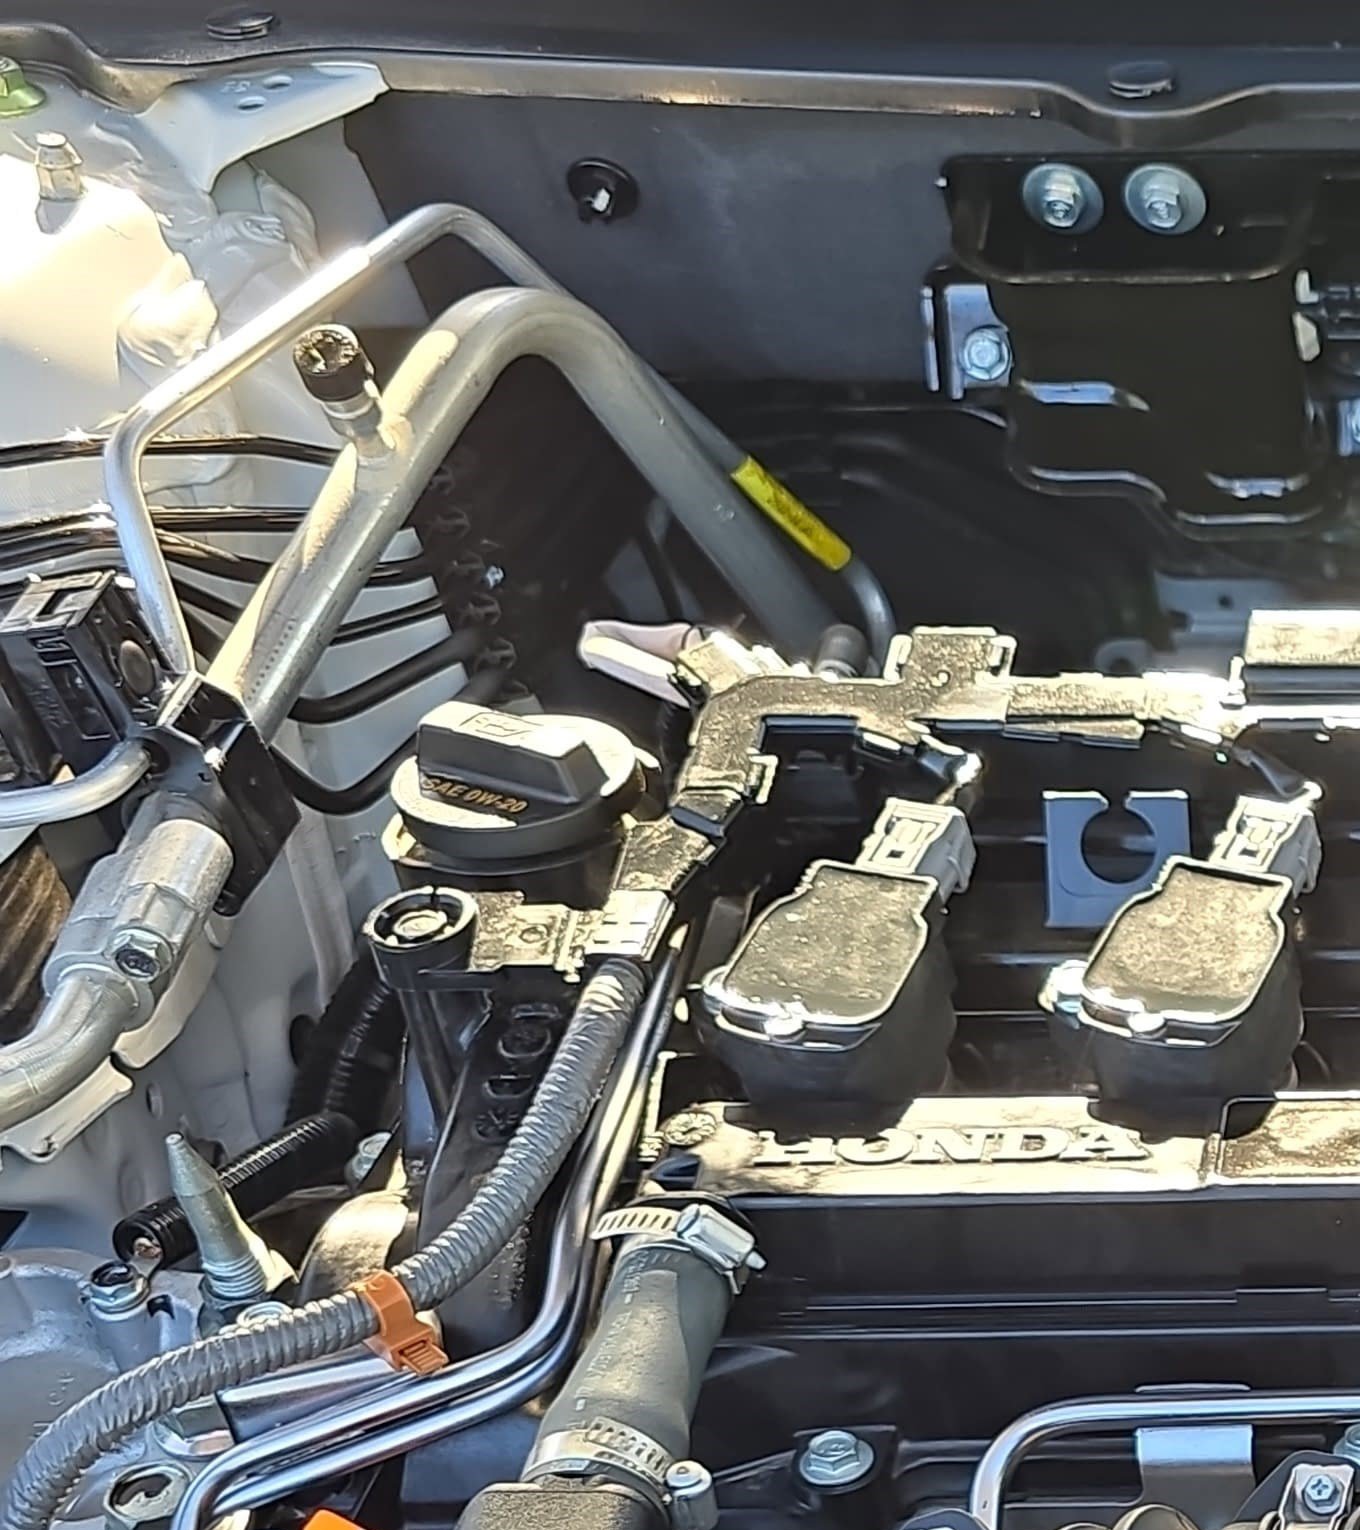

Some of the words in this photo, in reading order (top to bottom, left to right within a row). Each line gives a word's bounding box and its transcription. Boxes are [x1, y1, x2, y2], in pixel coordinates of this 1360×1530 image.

[420, 779, 469, 797] SAE
[463, 789, 528, 813] 0W-20
[752, 1126, 1151, 1167] HONDA
